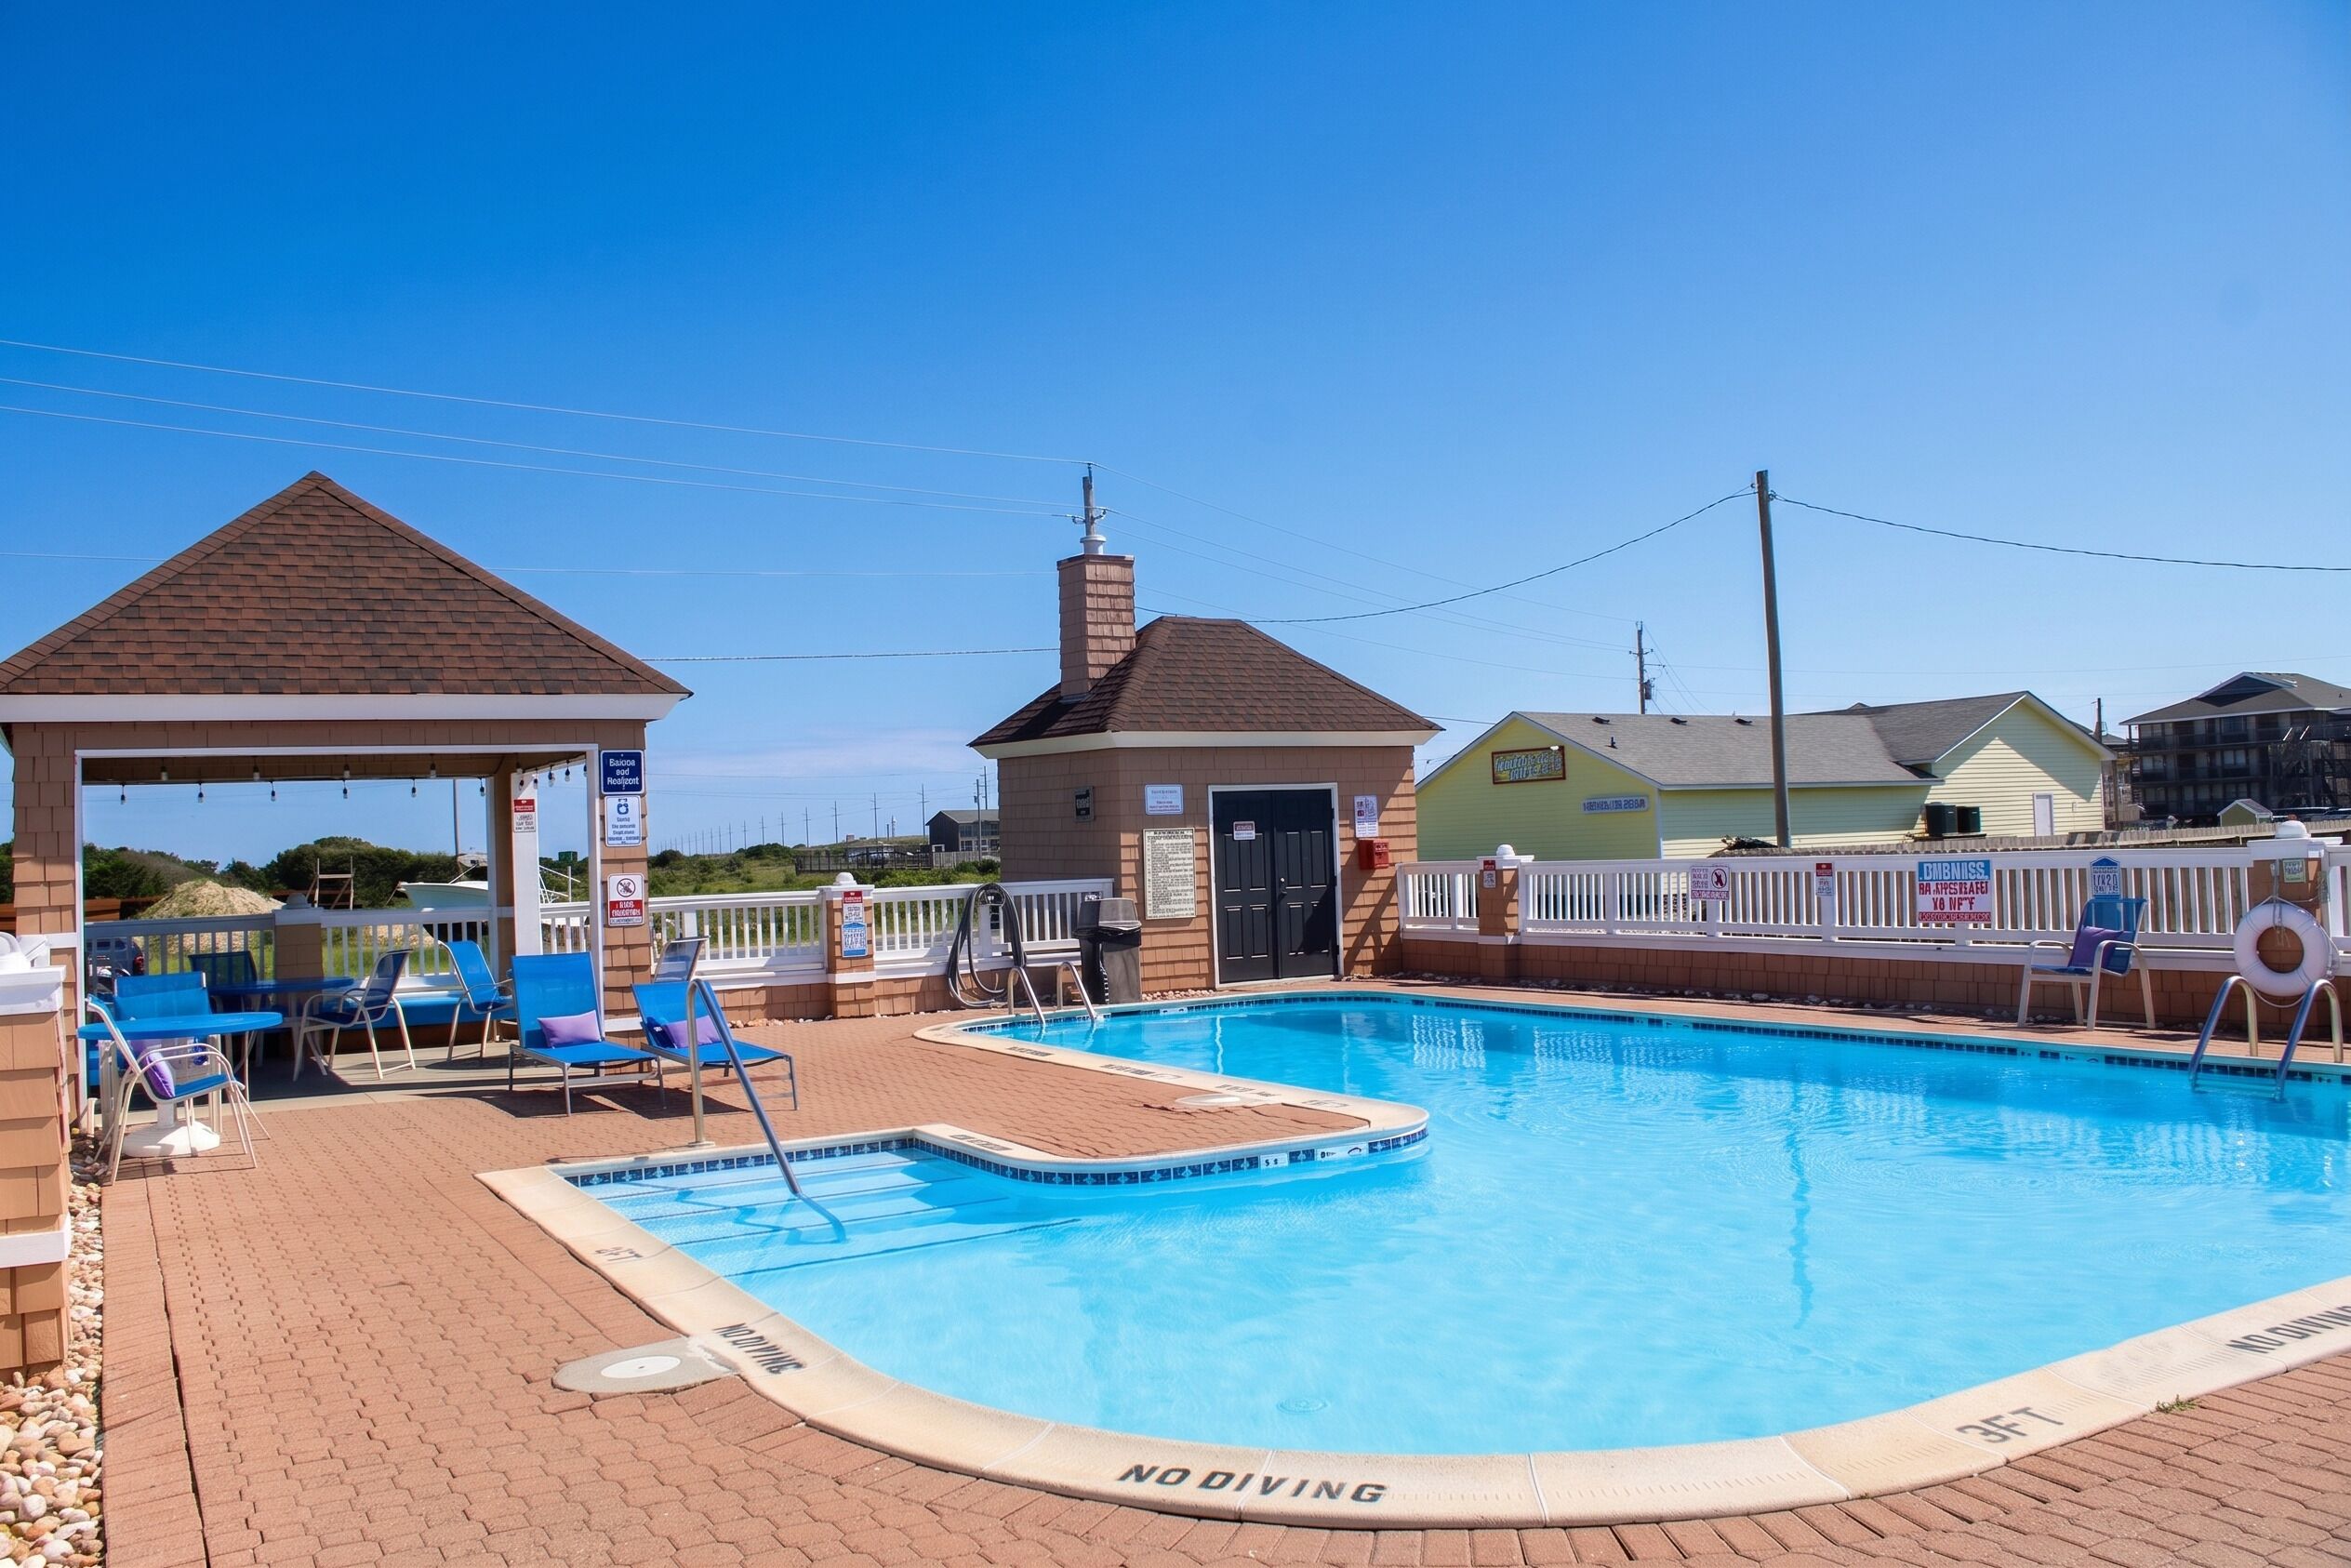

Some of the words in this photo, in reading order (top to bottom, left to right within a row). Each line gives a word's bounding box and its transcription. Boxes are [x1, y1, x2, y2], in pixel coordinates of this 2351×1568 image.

[711, 1322, 756, 1338] NO
[2225, 1334, 2287, 1354] NO
[728, 1335, 805, 1375] DIVING
[1955, 1406, 2065, 1443] 3FT
[1116, 1464, 1191, 1486] NO
[1197, 1470, 1388, 1504] DIVING
